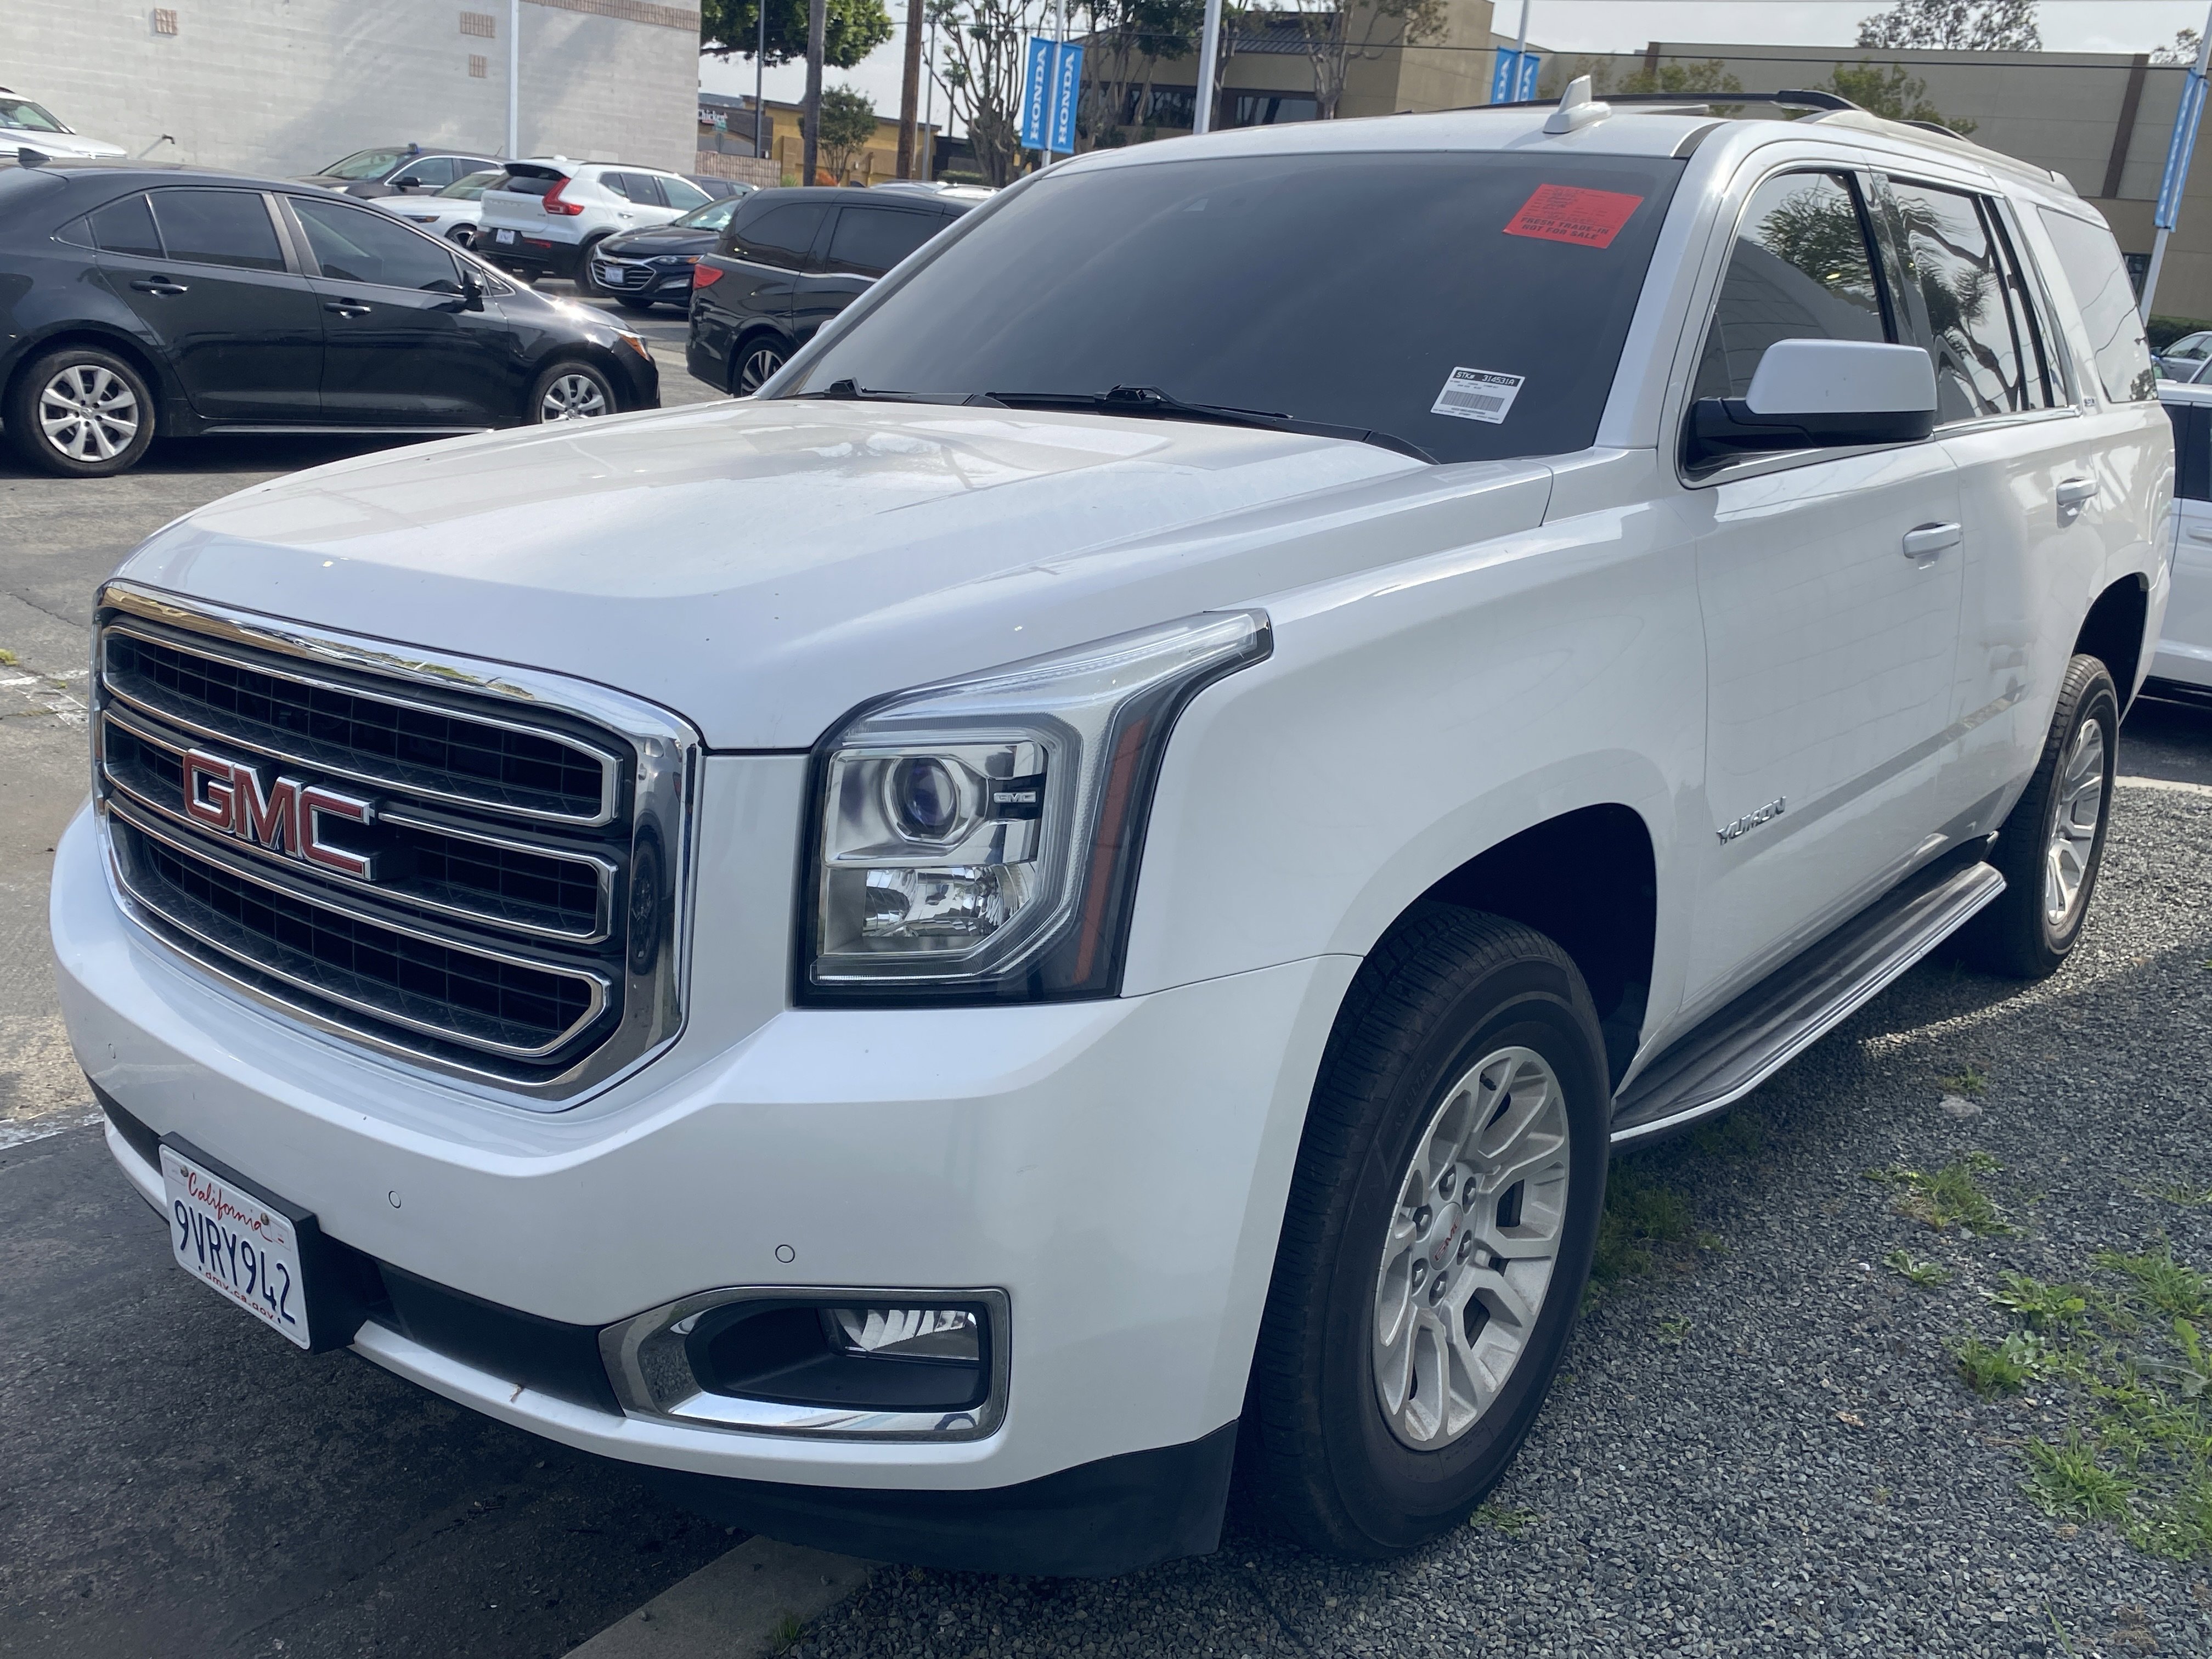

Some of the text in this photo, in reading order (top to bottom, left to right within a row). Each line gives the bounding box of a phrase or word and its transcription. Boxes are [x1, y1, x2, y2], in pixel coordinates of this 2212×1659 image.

[1030, 46, 1047, 140] HONDA
[1058, 52, 1075, 145] HONDA
[1520, 217, 1610, 235] FRESH TRADE-IN
[1521, 224, 1543, 232] NOT
[1570, 230, 1599, 240] SALE
[1481, 375, 1515, 386] 314531A
[183, 748, 372, 881] GMC
[994, 791, 1036, 803] GMC
[1716, 795, 1787, 845] YUKON
[187, 1171, 273, 1243] California
[173, 1199, 296, 1325] 9VRY942
[1434, 1211, 1463, 1263] GMC
[205, 1271, 275, 1321] dmv.ca.gov
